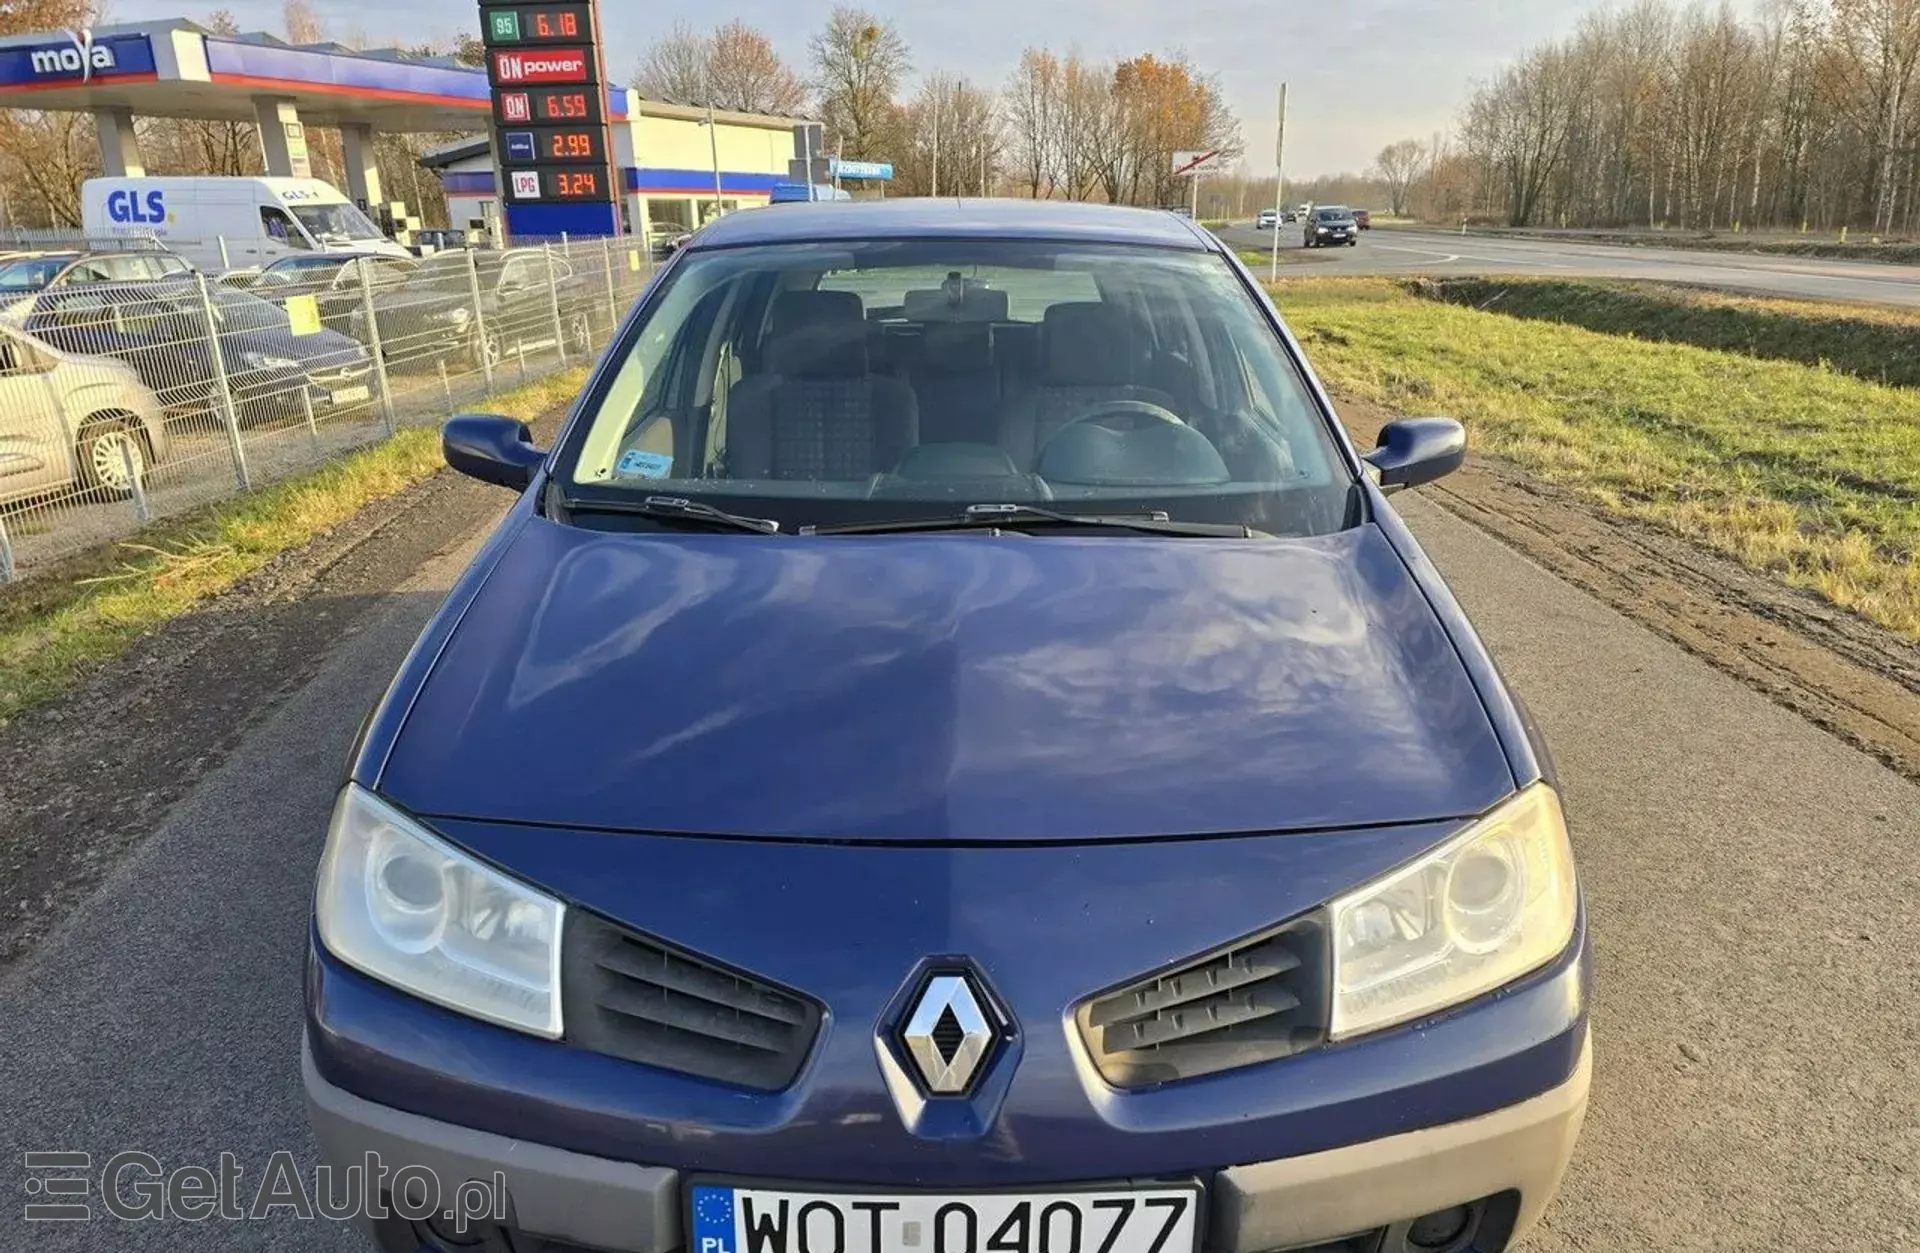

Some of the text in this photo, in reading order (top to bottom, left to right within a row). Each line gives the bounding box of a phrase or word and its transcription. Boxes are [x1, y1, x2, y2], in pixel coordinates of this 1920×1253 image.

[496, 12, 577, 36] 95 6.18
[31, 28, 116, 82] moya
[500, 54, 583, 79] ON power
[505, 95, 587, 117] ON 6.59
[553, 134, 592, 157] 2.99
[515, 173, 596, 195] LPG 3.24
[108, 190, 165, 223] GLS
[742, 1197, 1188, 1253] WOT 04077
[702, 1237, 730, 1253] PL
